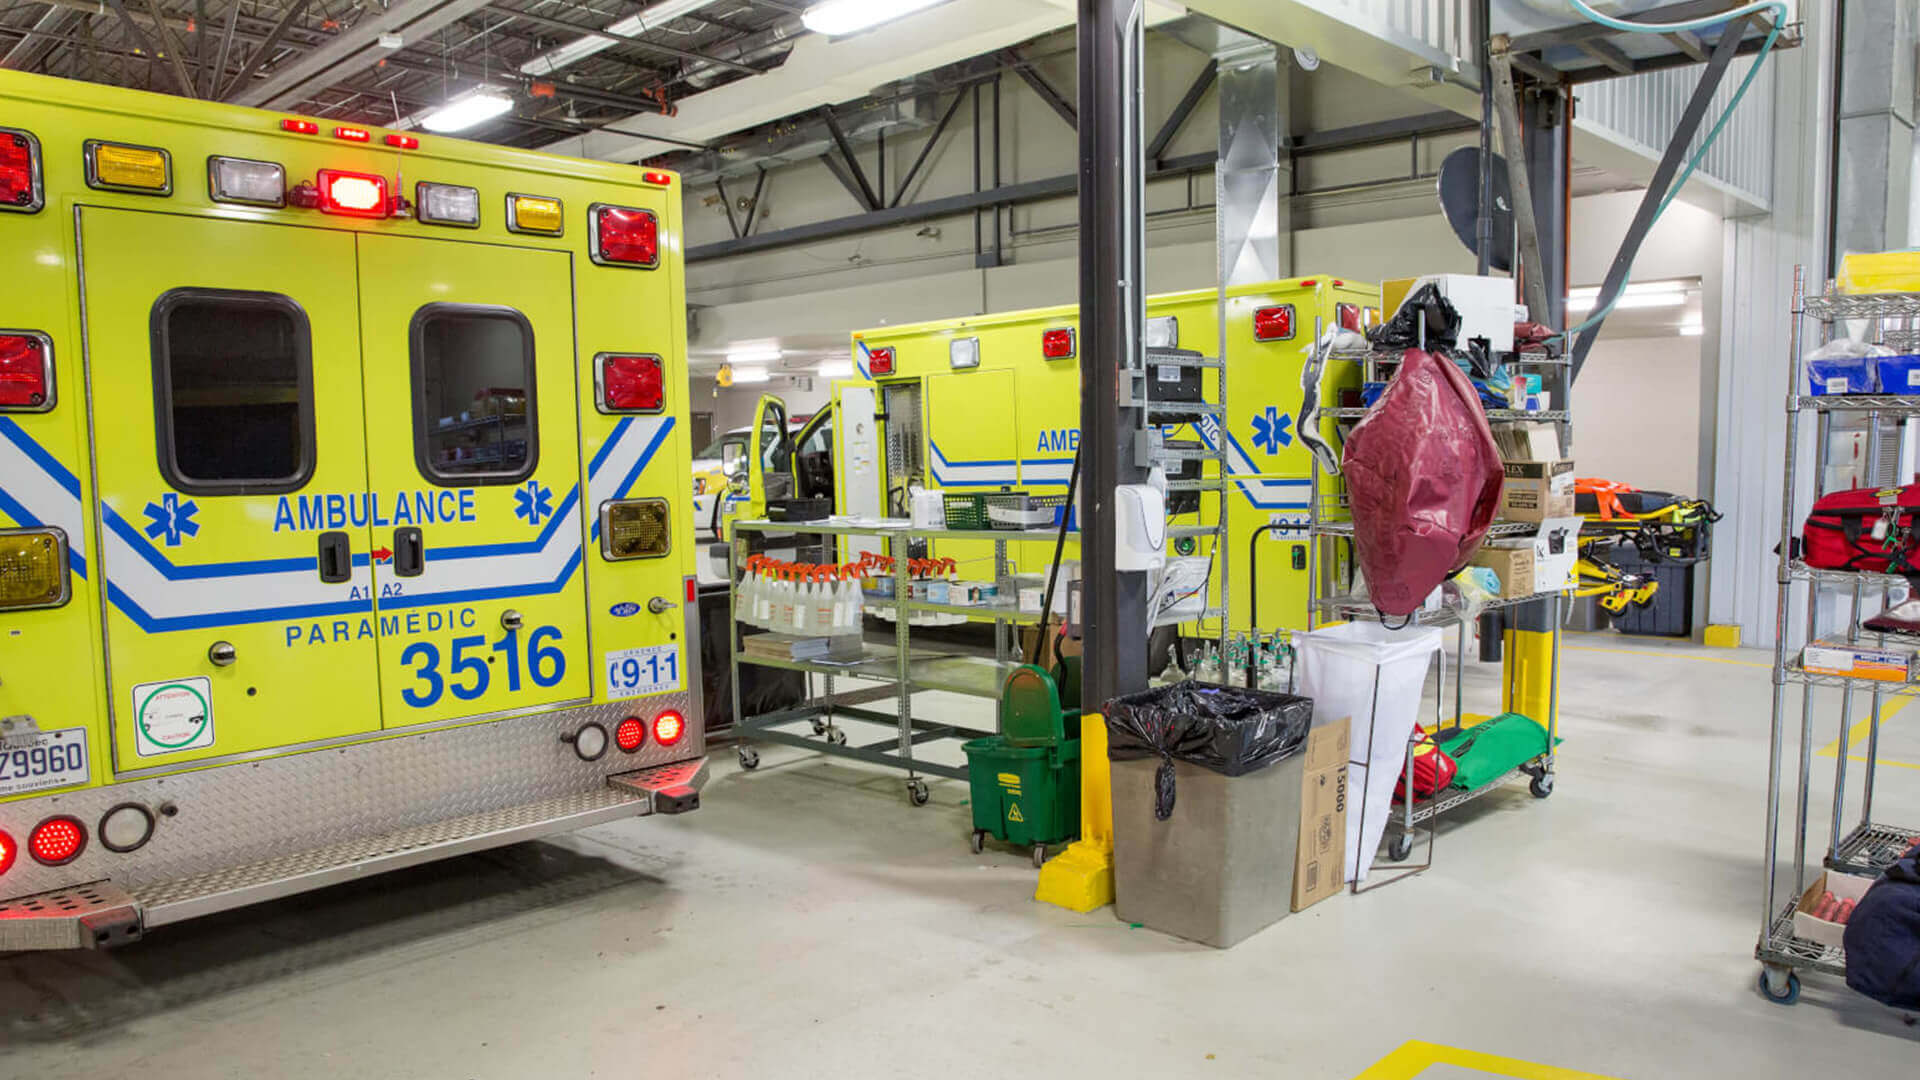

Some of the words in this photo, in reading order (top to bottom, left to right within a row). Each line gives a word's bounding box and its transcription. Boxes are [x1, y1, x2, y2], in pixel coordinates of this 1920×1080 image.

[273, 489, 476, 532] AMBULANCE
[350, 586, 370, 600] A1
[382, 582, 403, 597] A2
[286, 607, 476, 648] PARAMÉDIC
[400, 625, 567, 709] 3516
